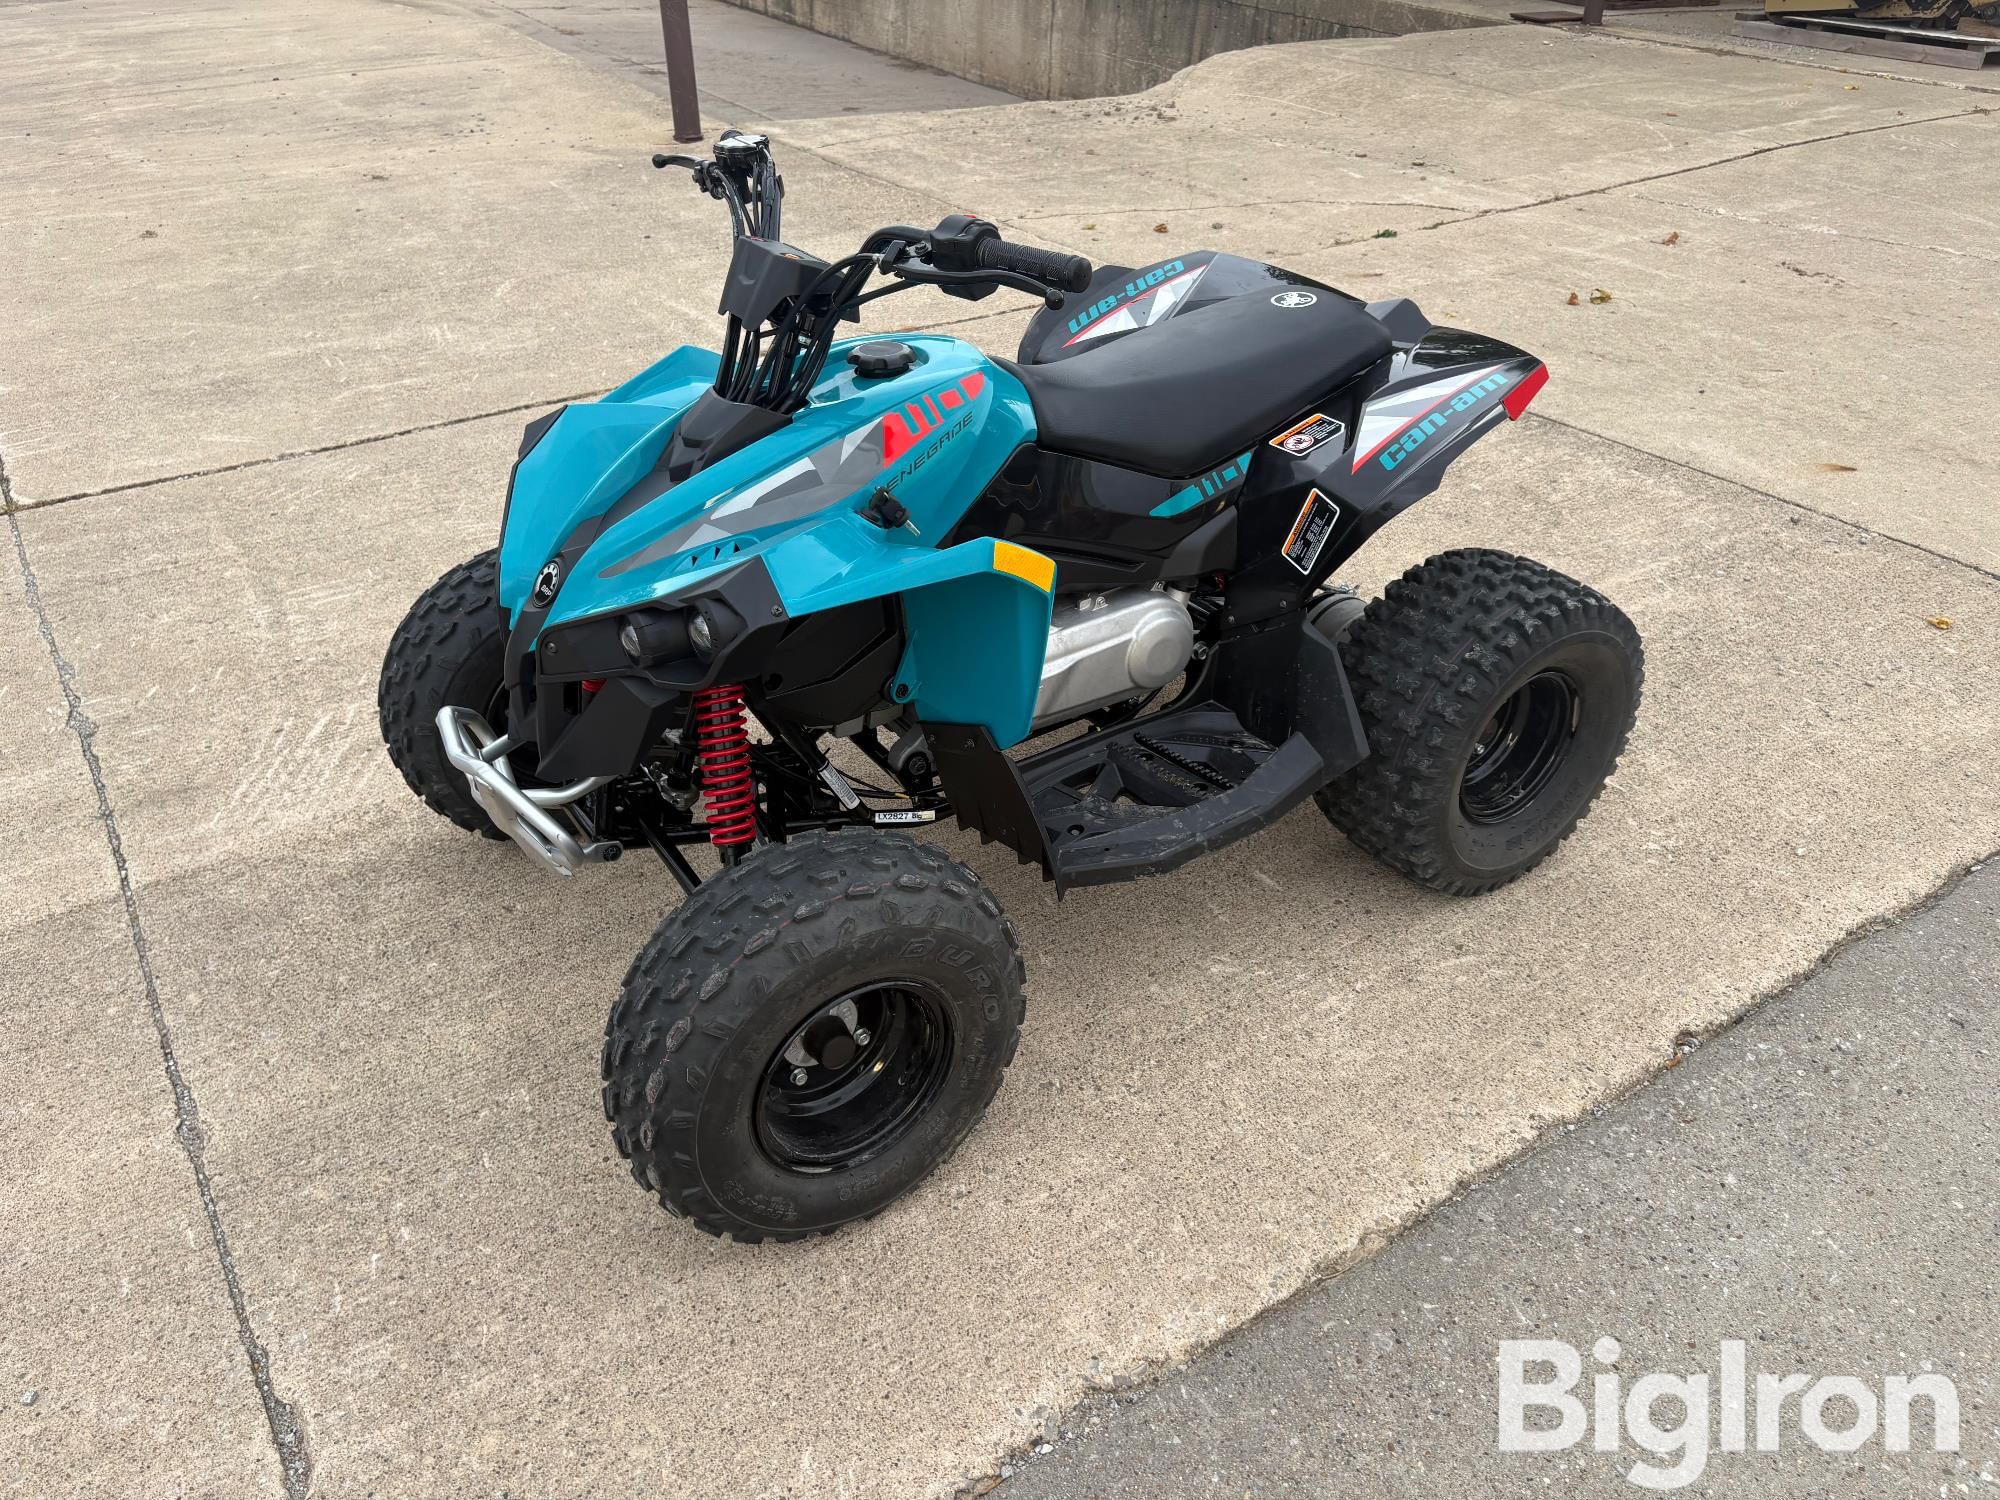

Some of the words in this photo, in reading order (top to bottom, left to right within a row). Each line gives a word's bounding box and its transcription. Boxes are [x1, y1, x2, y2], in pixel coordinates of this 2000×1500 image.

[1068, 260, 1184, 334] can-am
[875, 411, 973, 492] ENEGADE
[1379, 373, 1508, 471] can-am
[878, 812, 909, 820] LX2827
[900, 937, 1000, 1022] DURO
